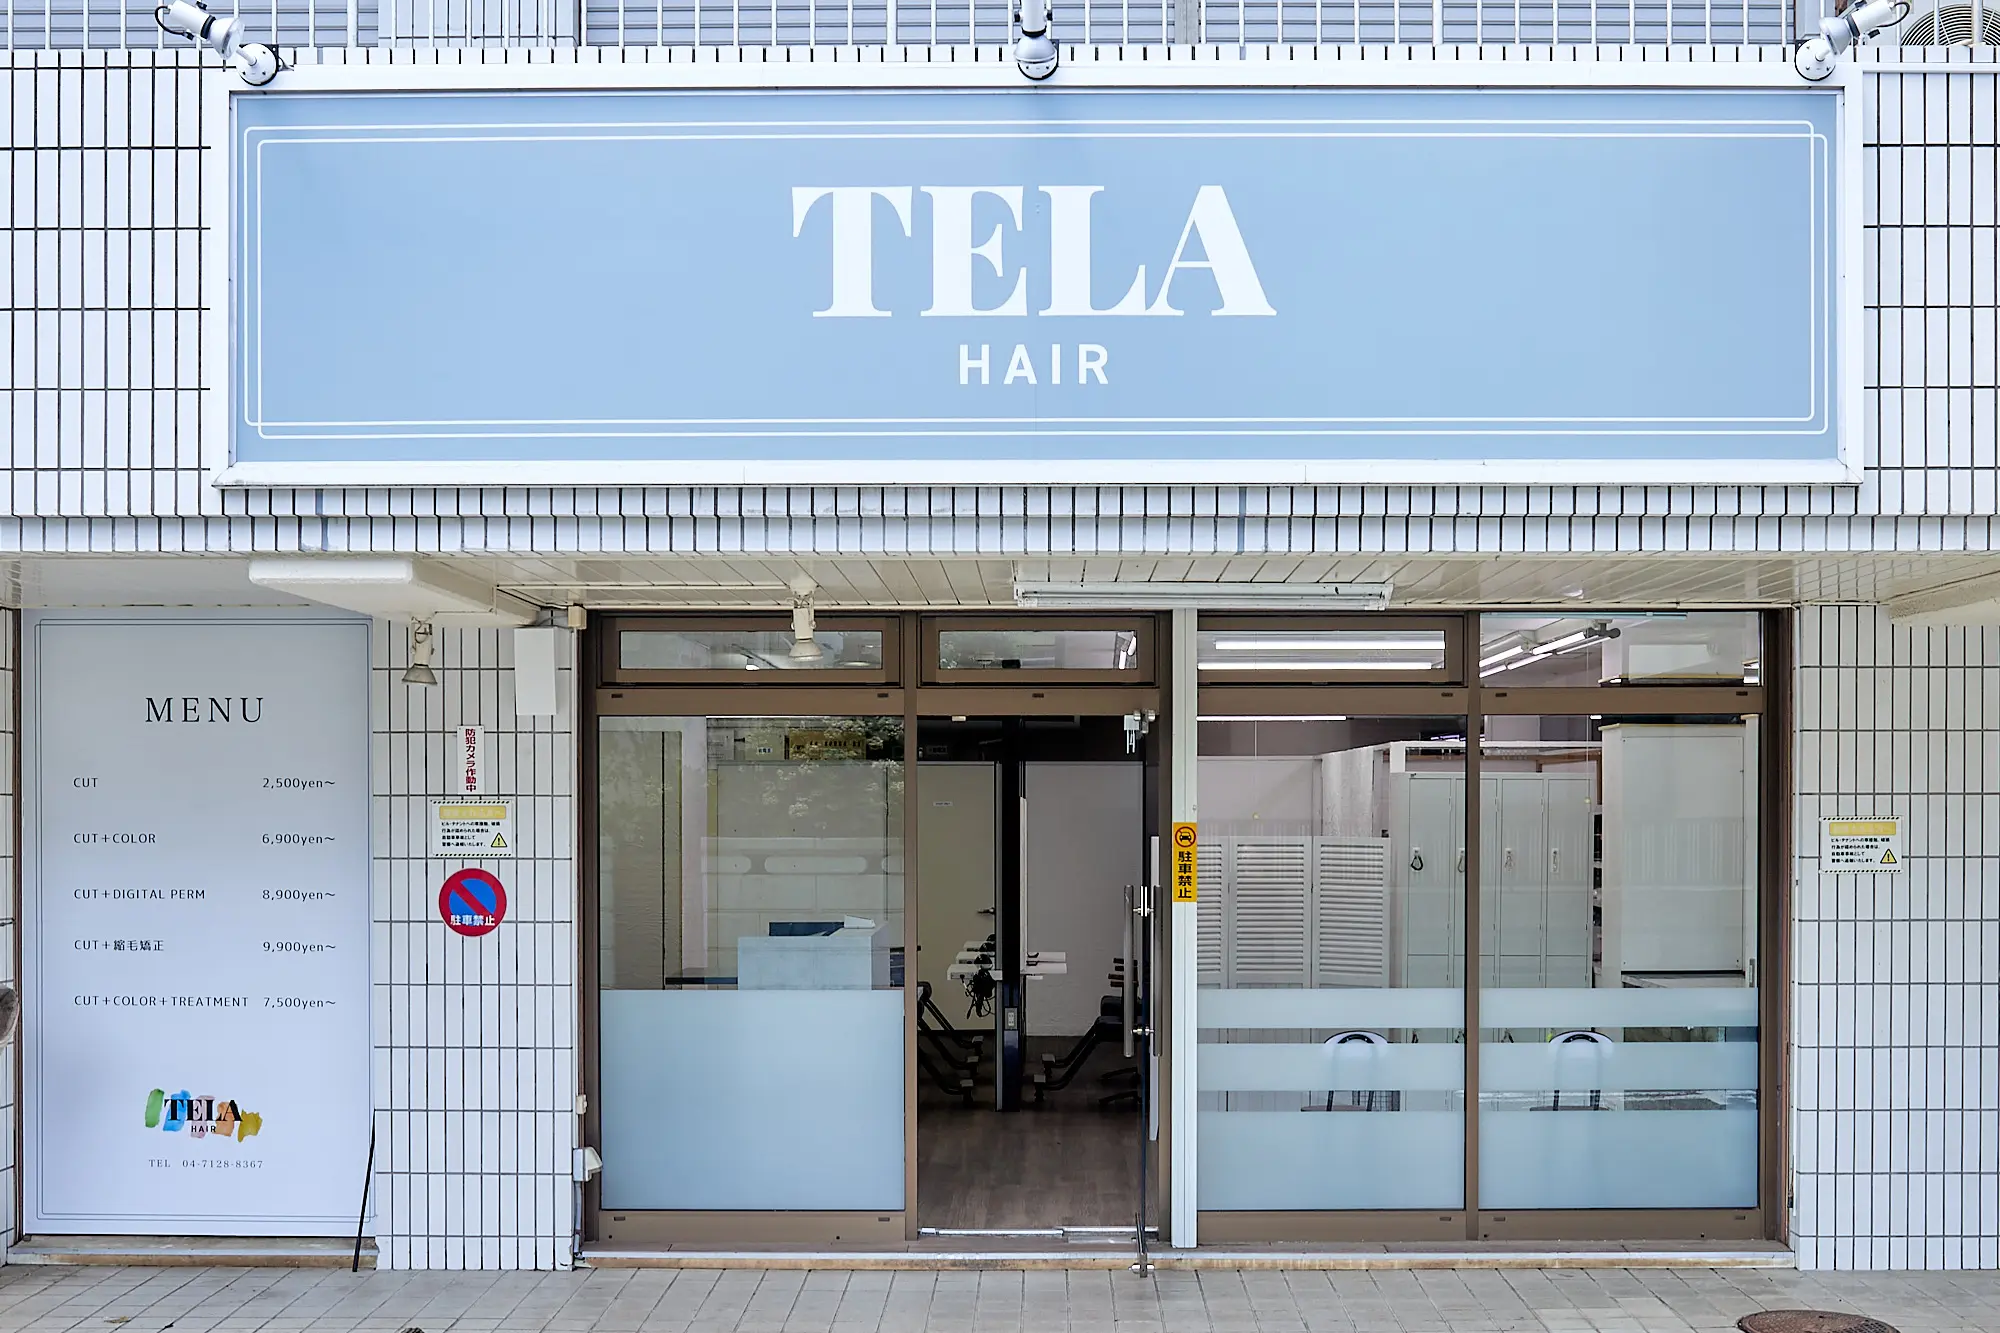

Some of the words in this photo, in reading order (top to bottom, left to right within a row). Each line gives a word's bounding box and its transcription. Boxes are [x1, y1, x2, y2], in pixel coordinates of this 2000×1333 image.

[791, 184, 1277, 318] TELA
[959, 343, 1109, 385] HAIR
[145, 697, 264, 723] MENU
[465, 728, 477, 792] 防犯カメラ作動中
[73, 777, 98, 788] CUT
[73, 833, 156, 844] CUT+COLOR
[1177, 850, 1193, 899] 駐車禁止
[170, 889, 206, 900] PERM
[449, 914, 496, 927] 駐車禁止
[164, 1099, 243, 1122] TELA
[190, 1125, 217, 1133] HAIR
[148, 1159, 171, 1169] TEL
[182, 1159, 263, 1169] 04-7128-8367
